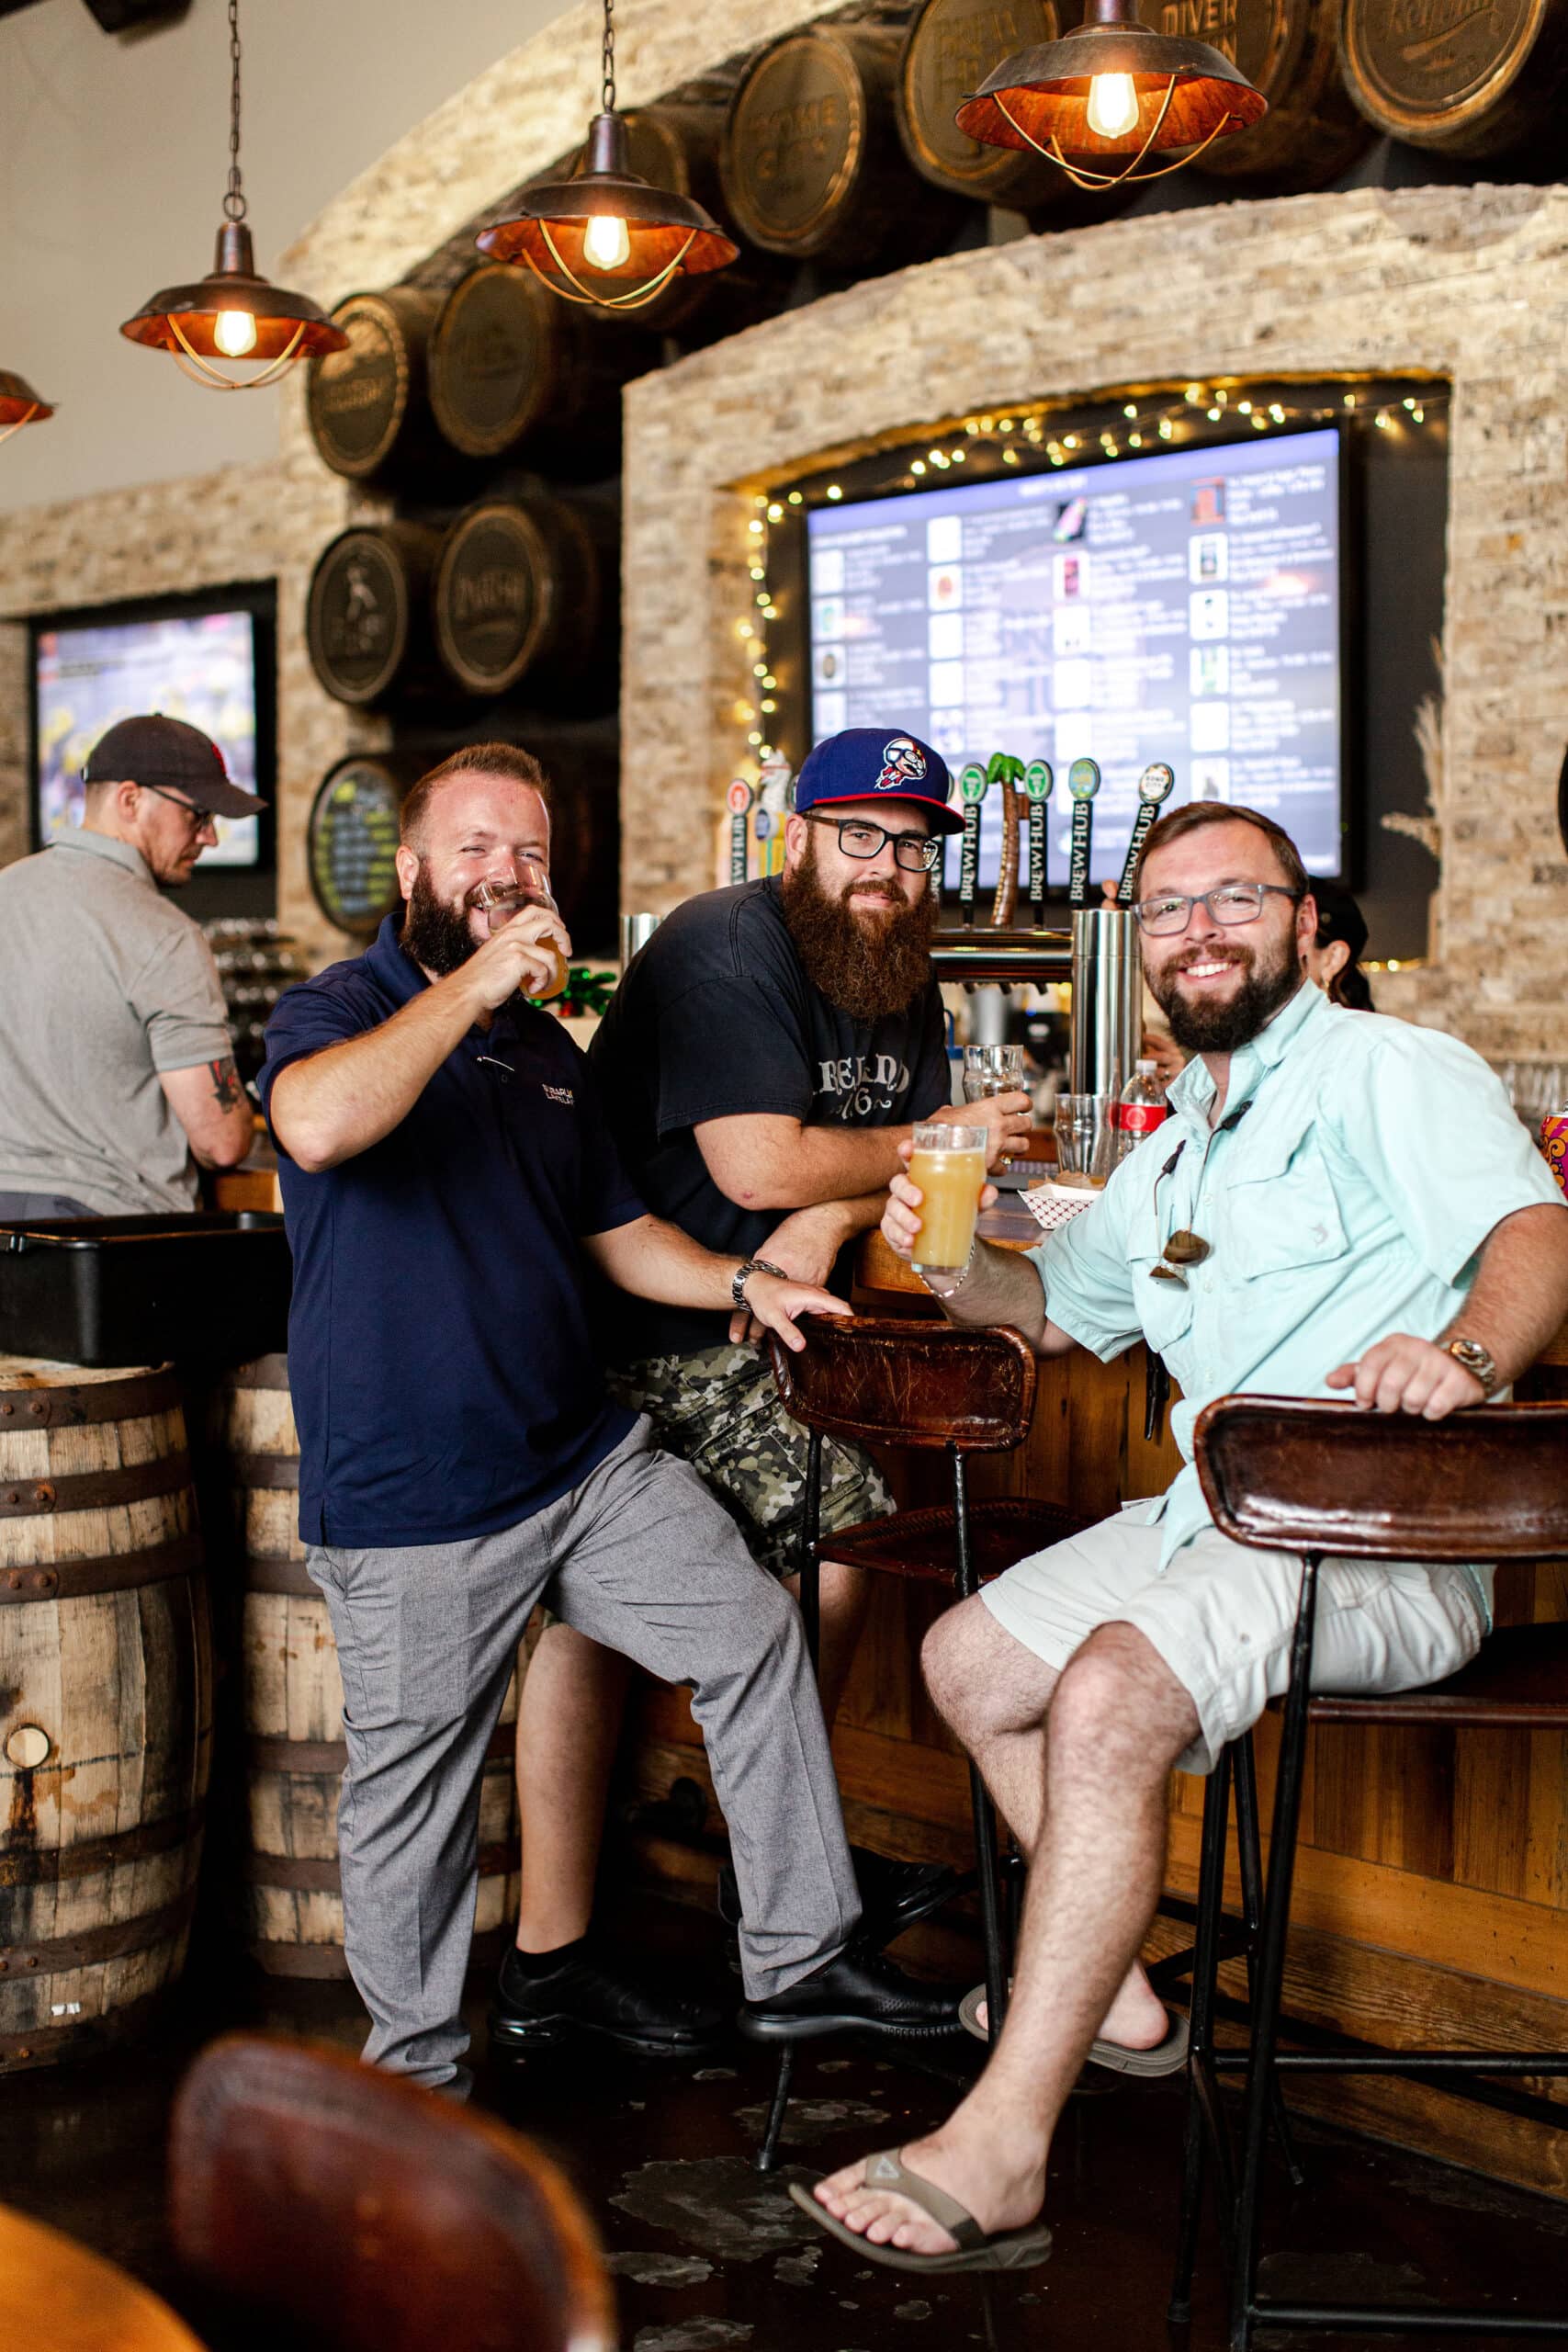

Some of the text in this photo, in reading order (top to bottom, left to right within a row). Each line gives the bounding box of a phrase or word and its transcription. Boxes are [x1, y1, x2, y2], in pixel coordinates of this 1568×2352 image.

[963, 805, 978, 850] HUB
[1029, 804, 1044, 848] HUB
[1073, 802, 1089, 848] HUB
[960, 851, 976, 901] BREW
[1030, 849, 1044, 900] BREW
[1070, 849, 1089, 901] BREW
[1118, 805, 1156, 900] BREW HUB
